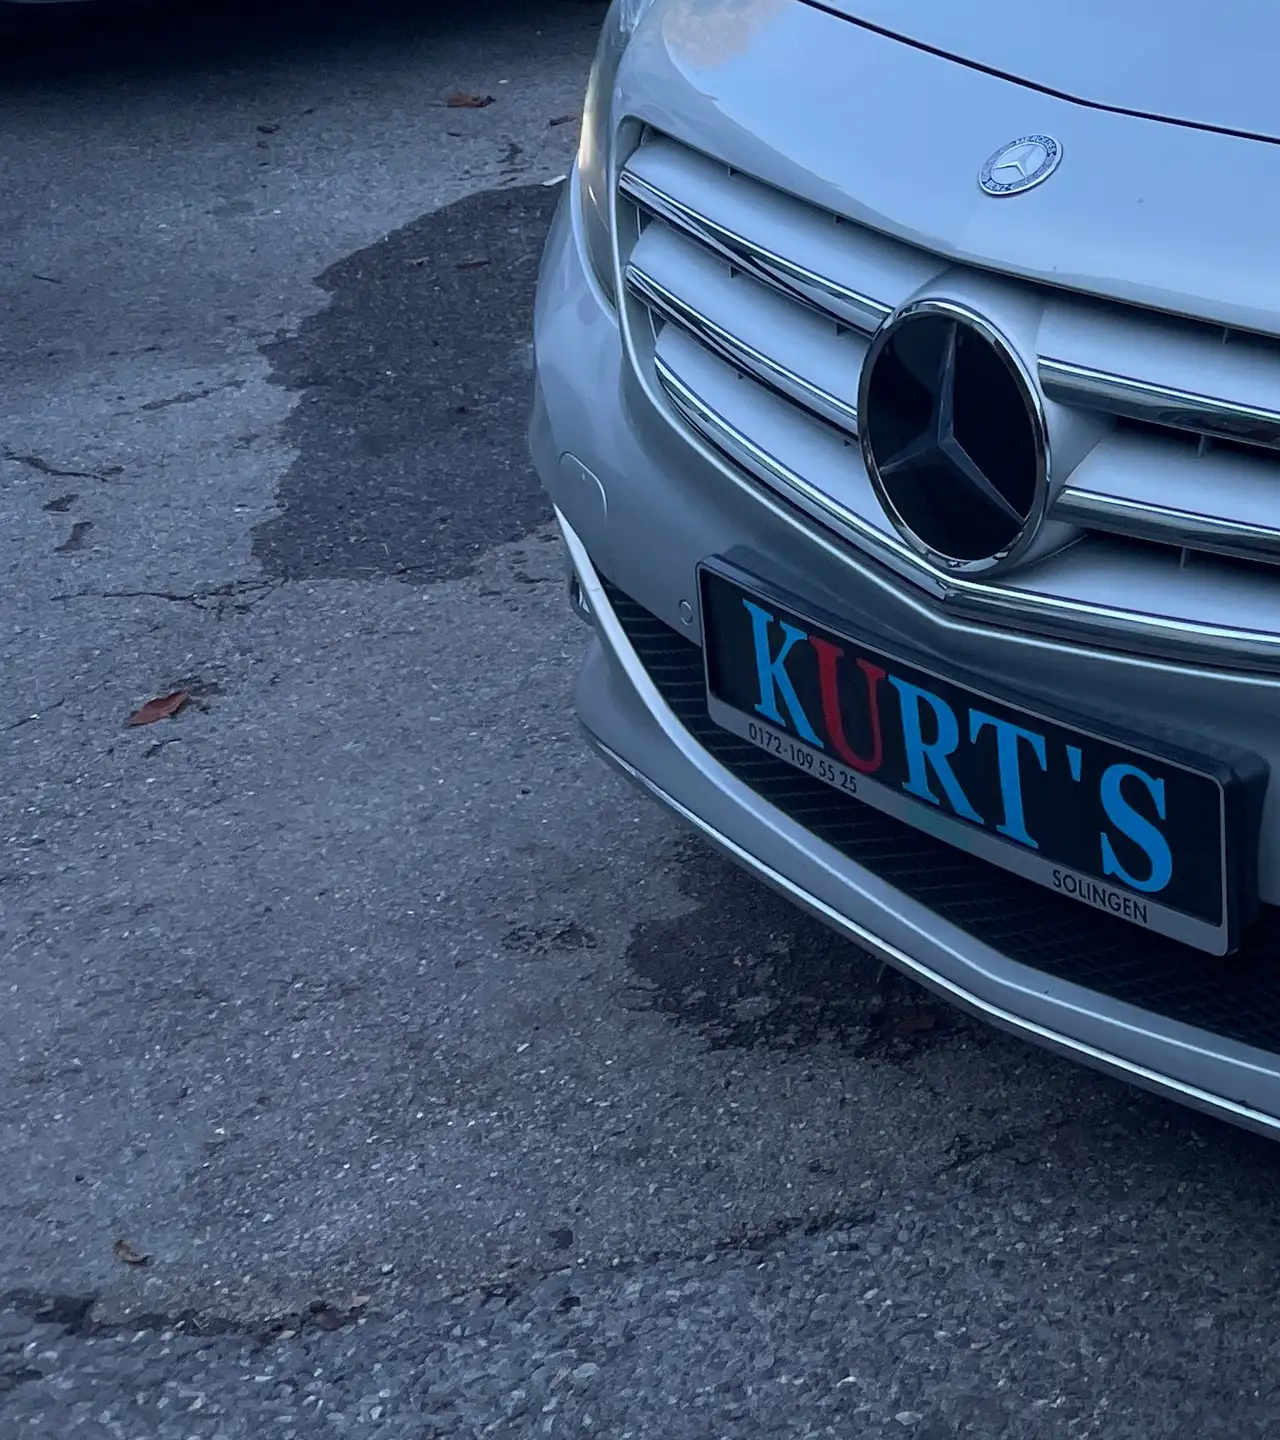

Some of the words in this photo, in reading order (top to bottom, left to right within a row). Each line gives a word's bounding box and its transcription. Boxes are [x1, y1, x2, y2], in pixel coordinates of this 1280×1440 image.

[742, 598, 1173, 893] KURT'S
[748, 722, 814, 770] 0172-109
[818, 760, 836, 782] 55
[840, 770, 858, 794] 25
[1052, 869, 1148, 924] SOLINGEN
